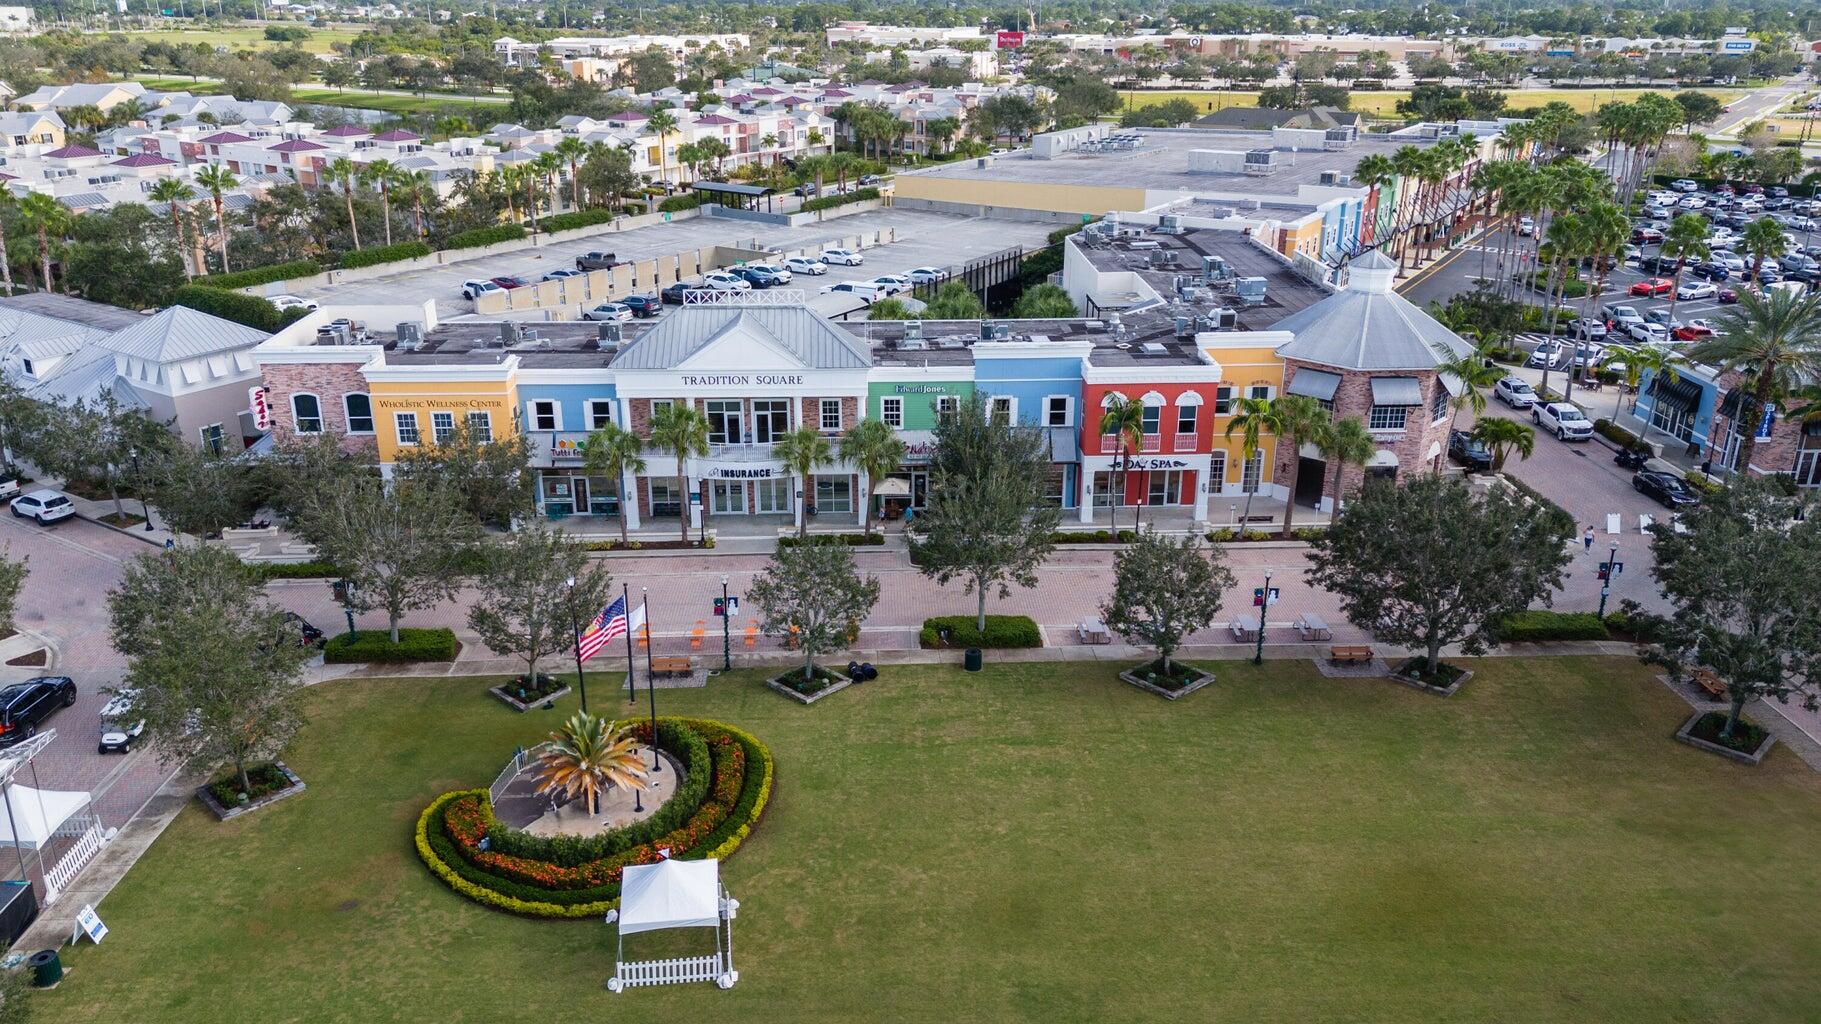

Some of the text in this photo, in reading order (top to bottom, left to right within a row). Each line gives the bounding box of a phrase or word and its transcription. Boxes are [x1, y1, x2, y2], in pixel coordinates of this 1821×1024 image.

[681, 375, 804, 386] TRADITION SQUARE
[426, 399, 469, 408] WELLNESS
[469, 399, 502, 408] CENTER
[551, 448, 571, 457] Tutti
[1150, 459, 1173, 470] SPA
[720, 469, 771, 478] INSURANCE
